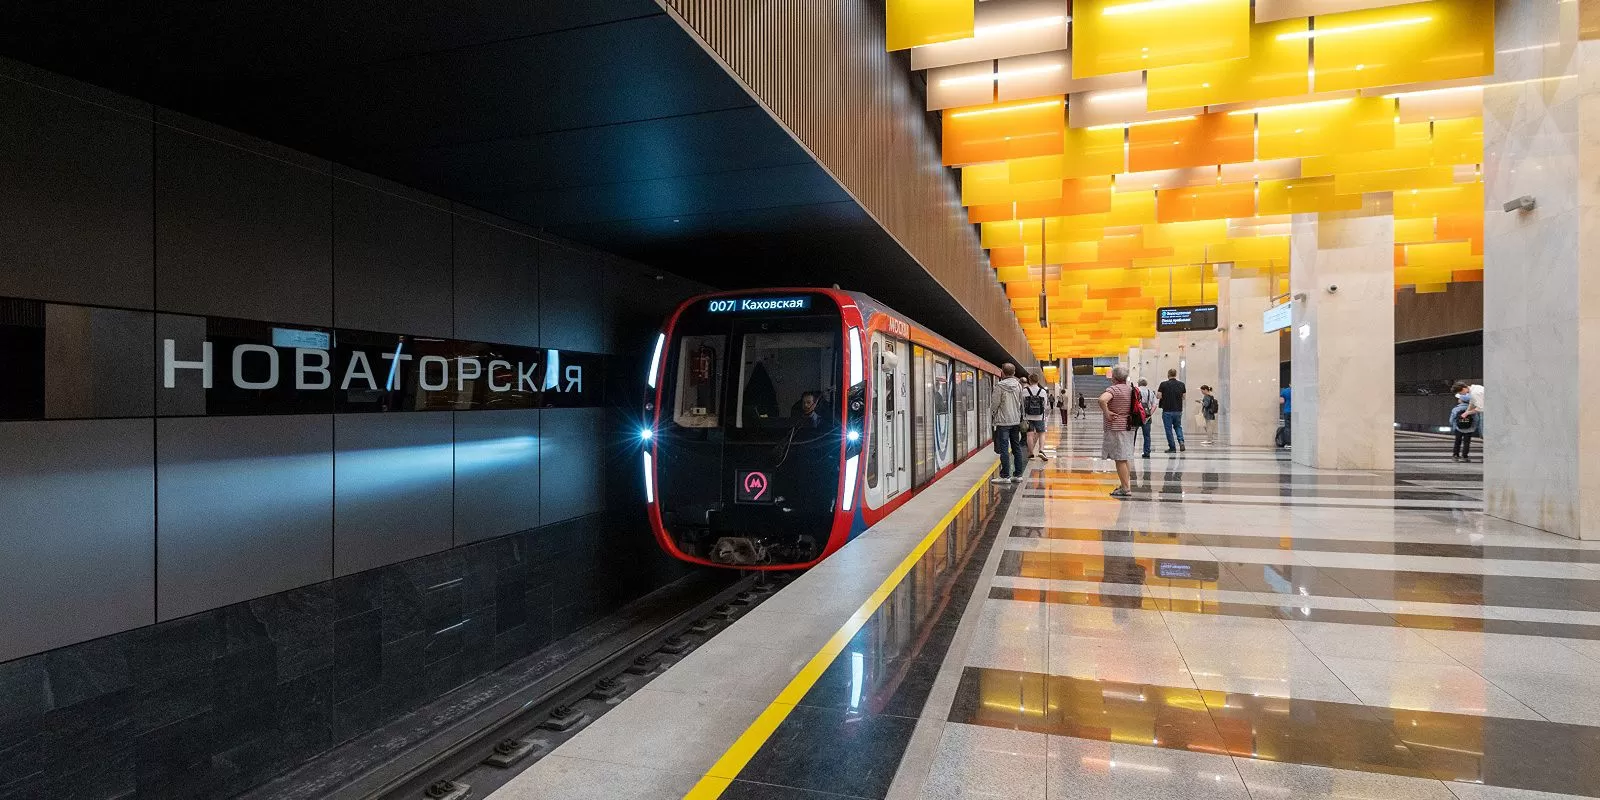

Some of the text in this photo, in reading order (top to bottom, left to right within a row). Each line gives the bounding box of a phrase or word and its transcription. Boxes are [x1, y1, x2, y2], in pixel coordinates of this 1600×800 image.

[710, 300, 804, 311] 007 Каховская
[164, 339, 582, 392] НОВАТОРСКАЯ
